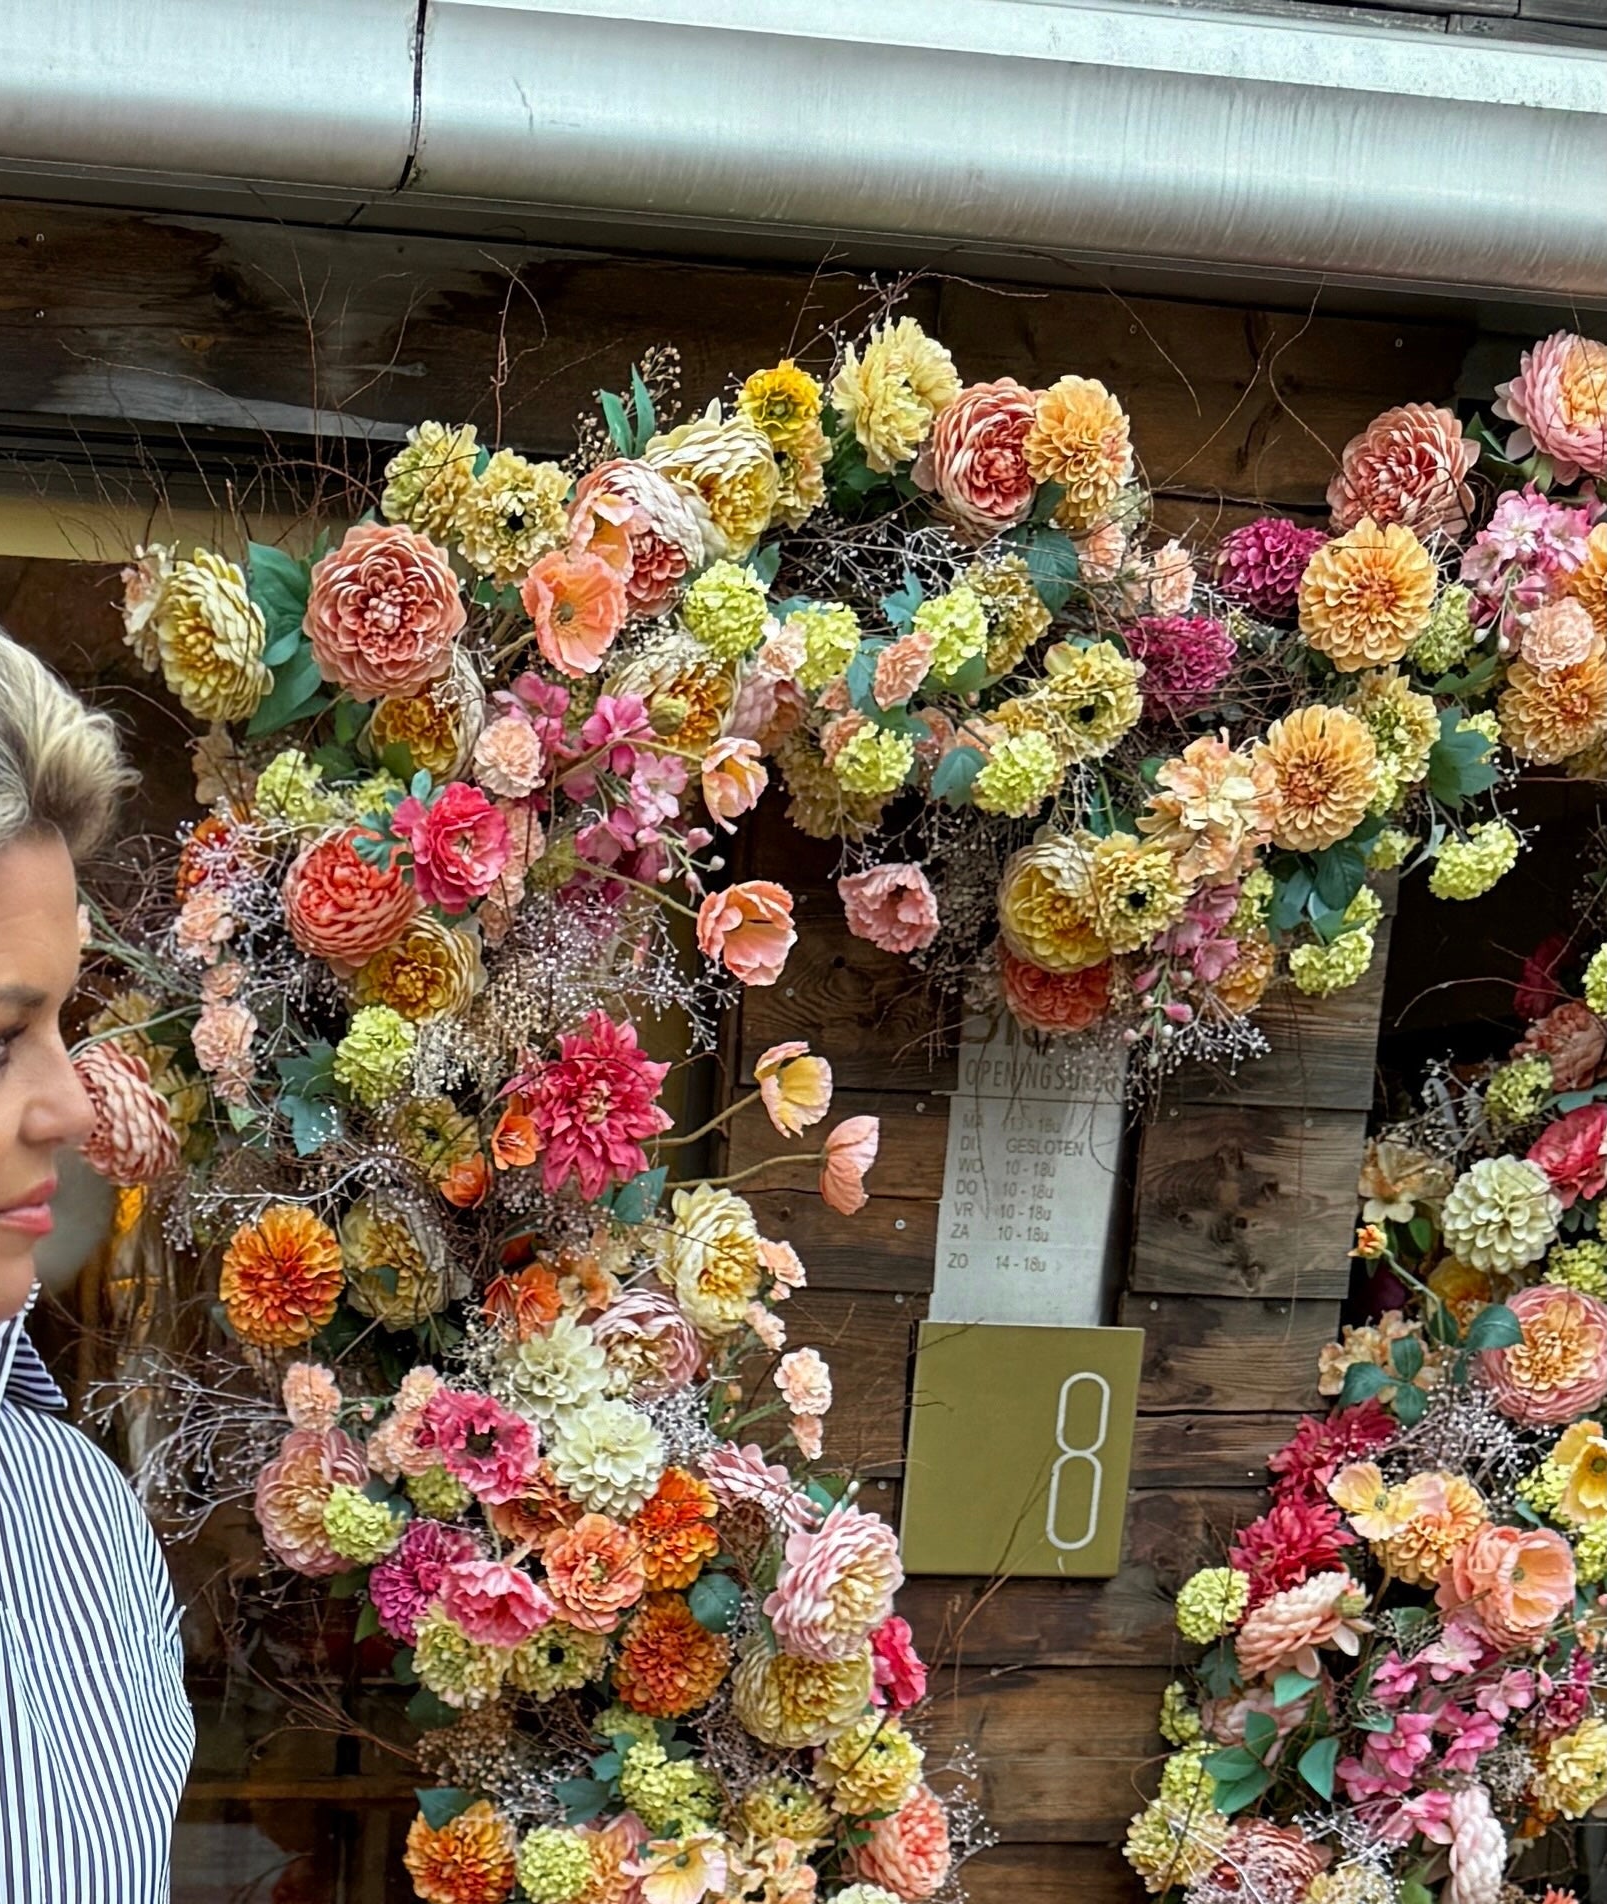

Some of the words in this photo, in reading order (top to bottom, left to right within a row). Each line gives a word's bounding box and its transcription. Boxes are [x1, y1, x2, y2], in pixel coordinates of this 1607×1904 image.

[960, 1136, 976, 1151] DI
[1006, 1138, 1085, 1156] GESLOTEN
[958, 1157, 983, 1173] WO
[1005, 1160, 1020, 1175] 10
[1034, 1161, 1056, 1178] 18u
[956, 1179, 978, 1196] DO
[1003, 1181, 1017, 1196] 10
[1031, 1183, 1054, 1199] 18u
[954, 1202, 974, 1217] VR
[1000, 1204, 1015, 1219] 10
[1029, 1205, 1052, 1221] 18u
[950, 1223, 970, 1239] ZA
[998, 1226, 1013, 1241] 10
[1027, 1227, 1049, 1242] 18u
[947, 1253, 969, 1269] ZO
[996, 1255, 1010, 1270] 14
[1024, 1256, 1047, 1272] 18u
[1046, 1371, 1110, 1550] 8
